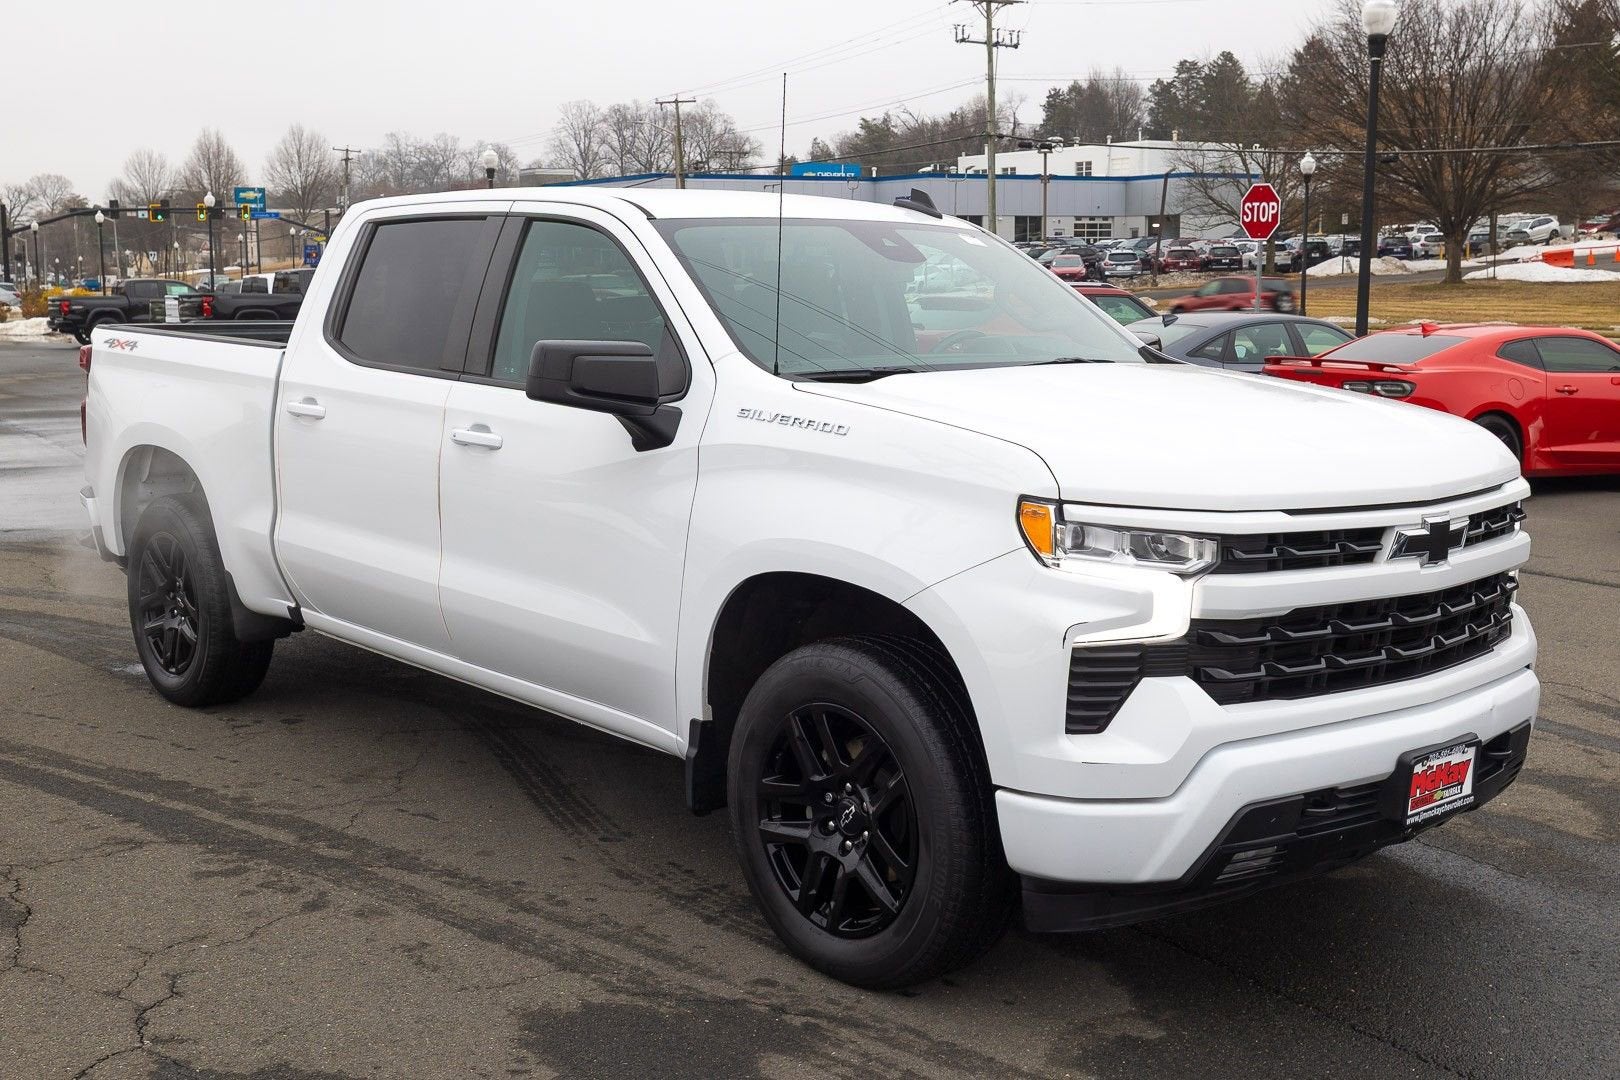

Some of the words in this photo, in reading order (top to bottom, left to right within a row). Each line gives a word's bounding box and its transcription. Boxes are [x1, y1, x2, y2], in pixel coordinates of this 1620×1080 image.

[1243, 201, 1278, 223] STOP
[736, 408, 851, 436] SILVERADO
[1409, 758, 1473, 798] McKay
